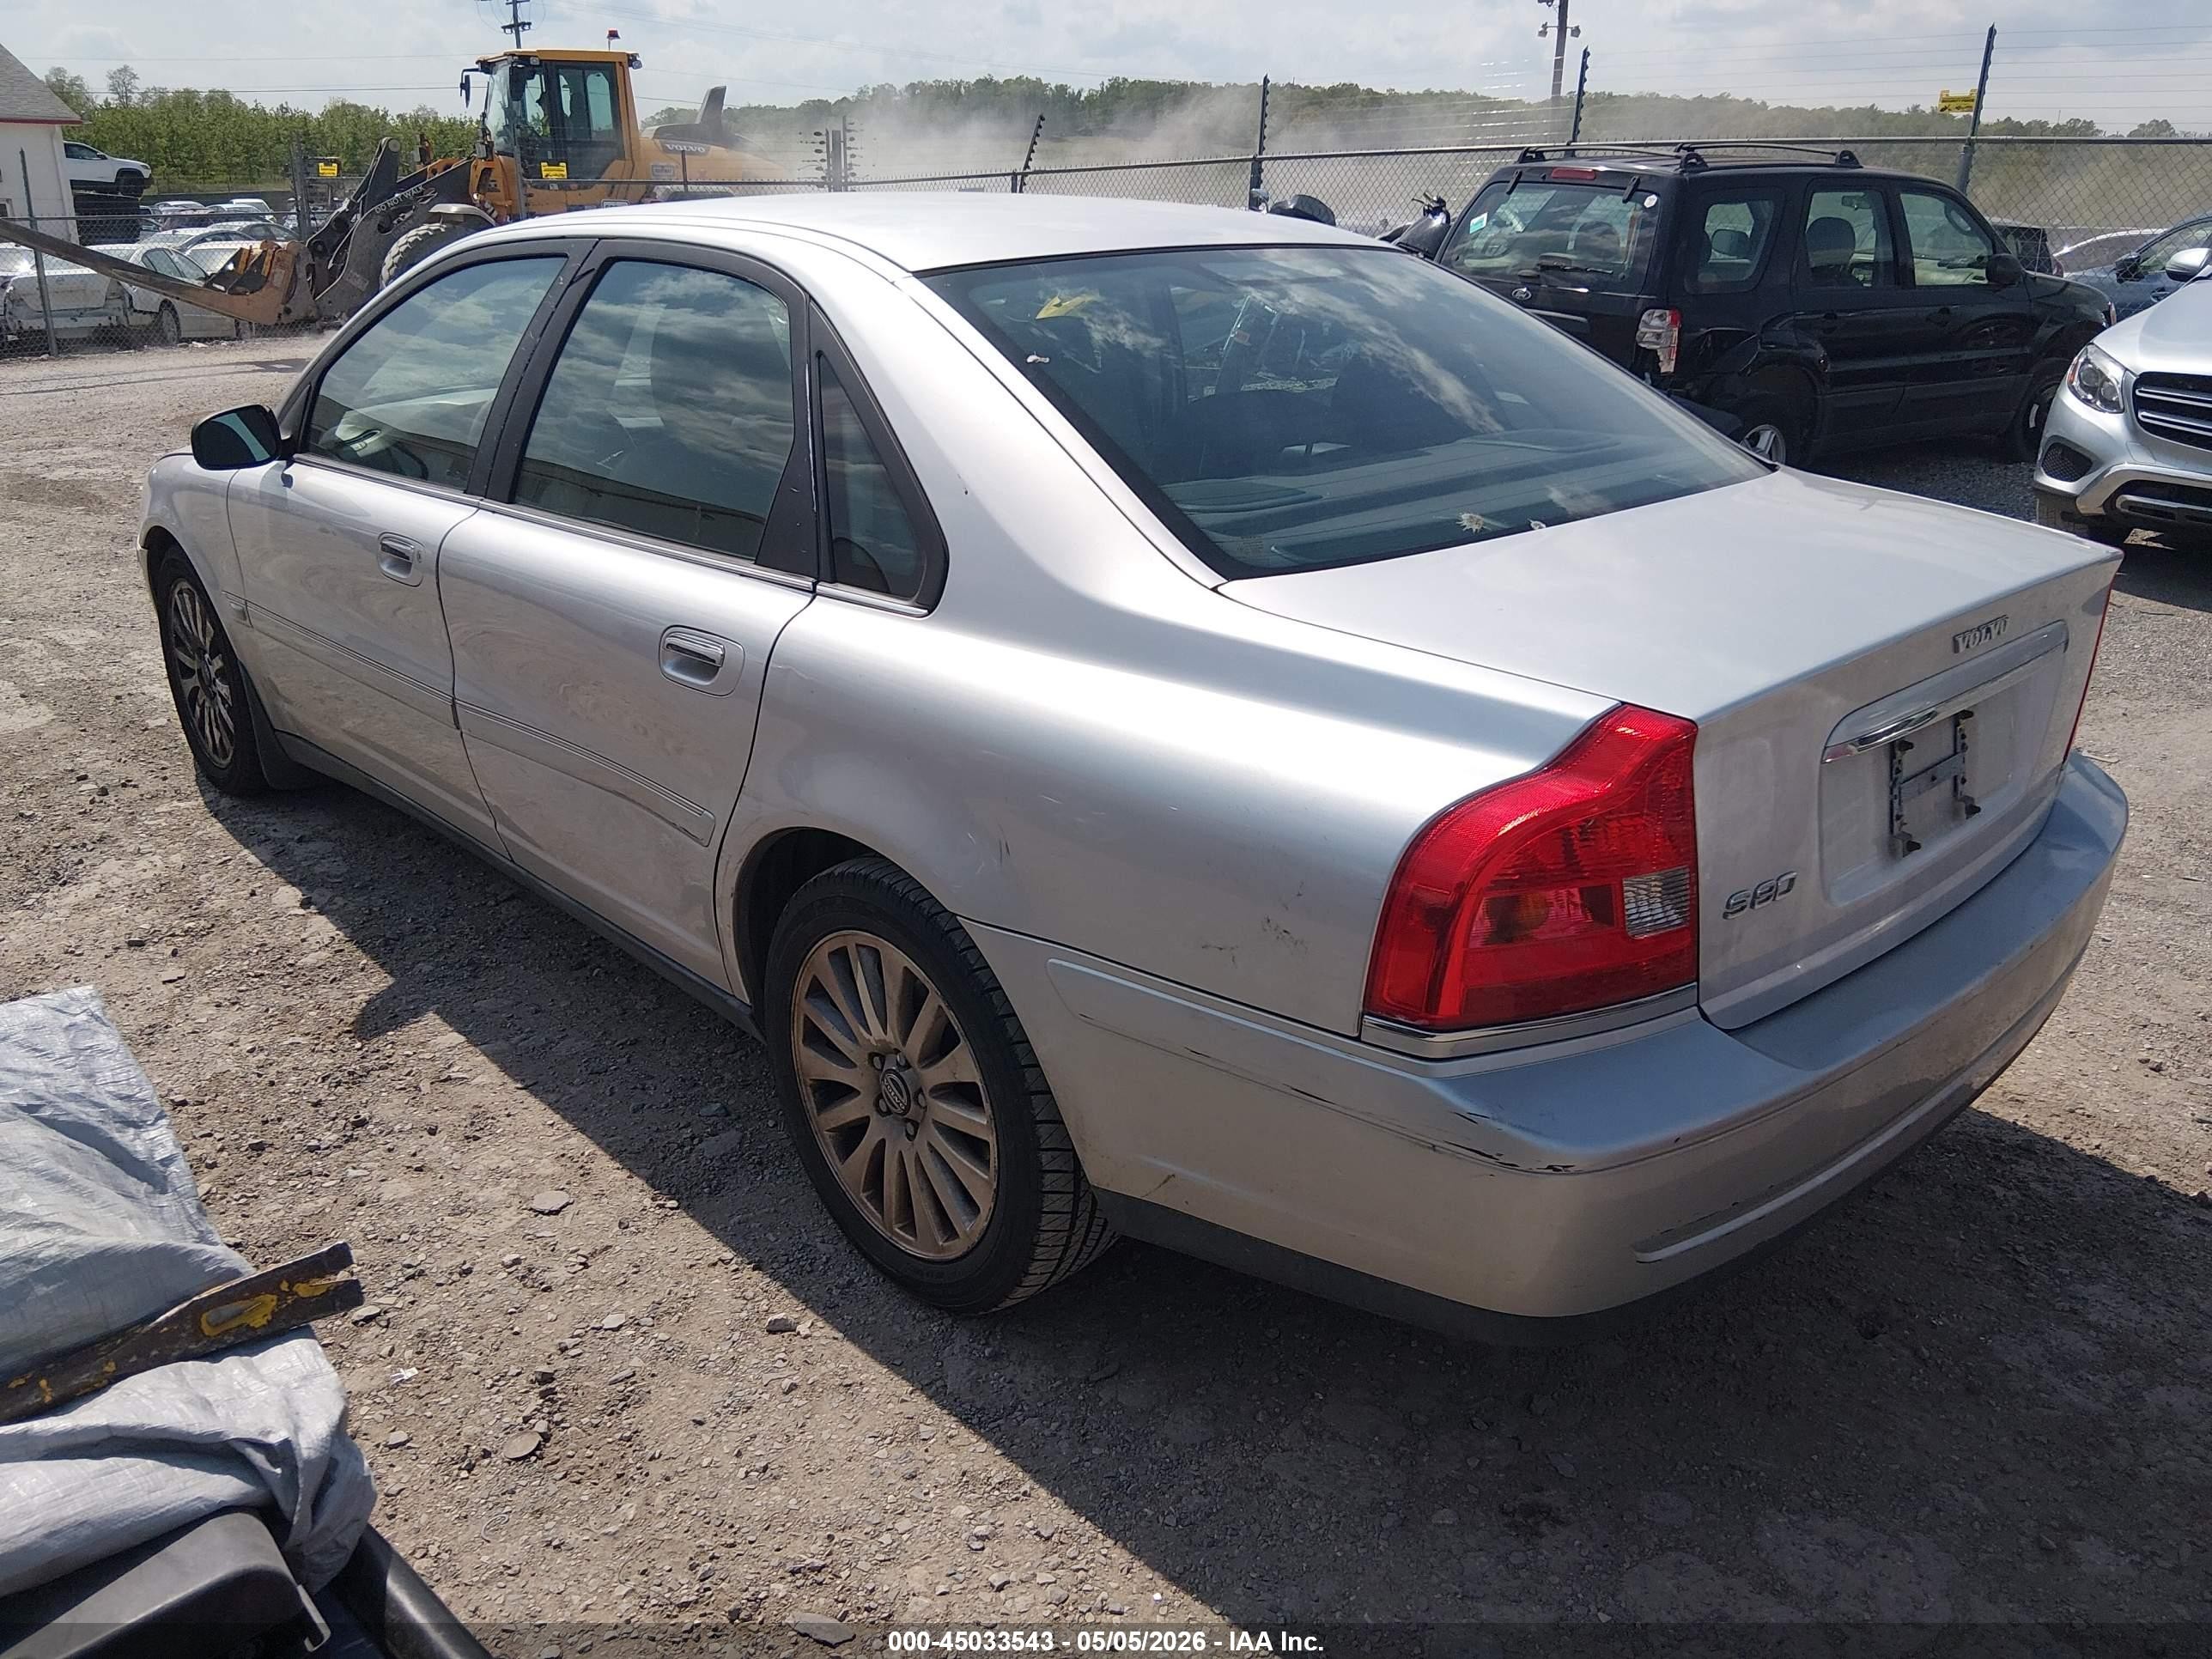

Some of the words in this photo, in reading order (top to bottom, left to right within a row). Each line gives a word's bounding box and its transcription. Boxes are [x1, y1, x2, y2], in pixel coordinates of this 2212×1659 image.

[665, 143, 706, 153] VOLVO
[387, 196, 403, 207] NOT
[403, 185, 425, 198] WALK
[1953, 615, 2008, 653] VOLVO
[1723, 871, 1797, 920] S80
